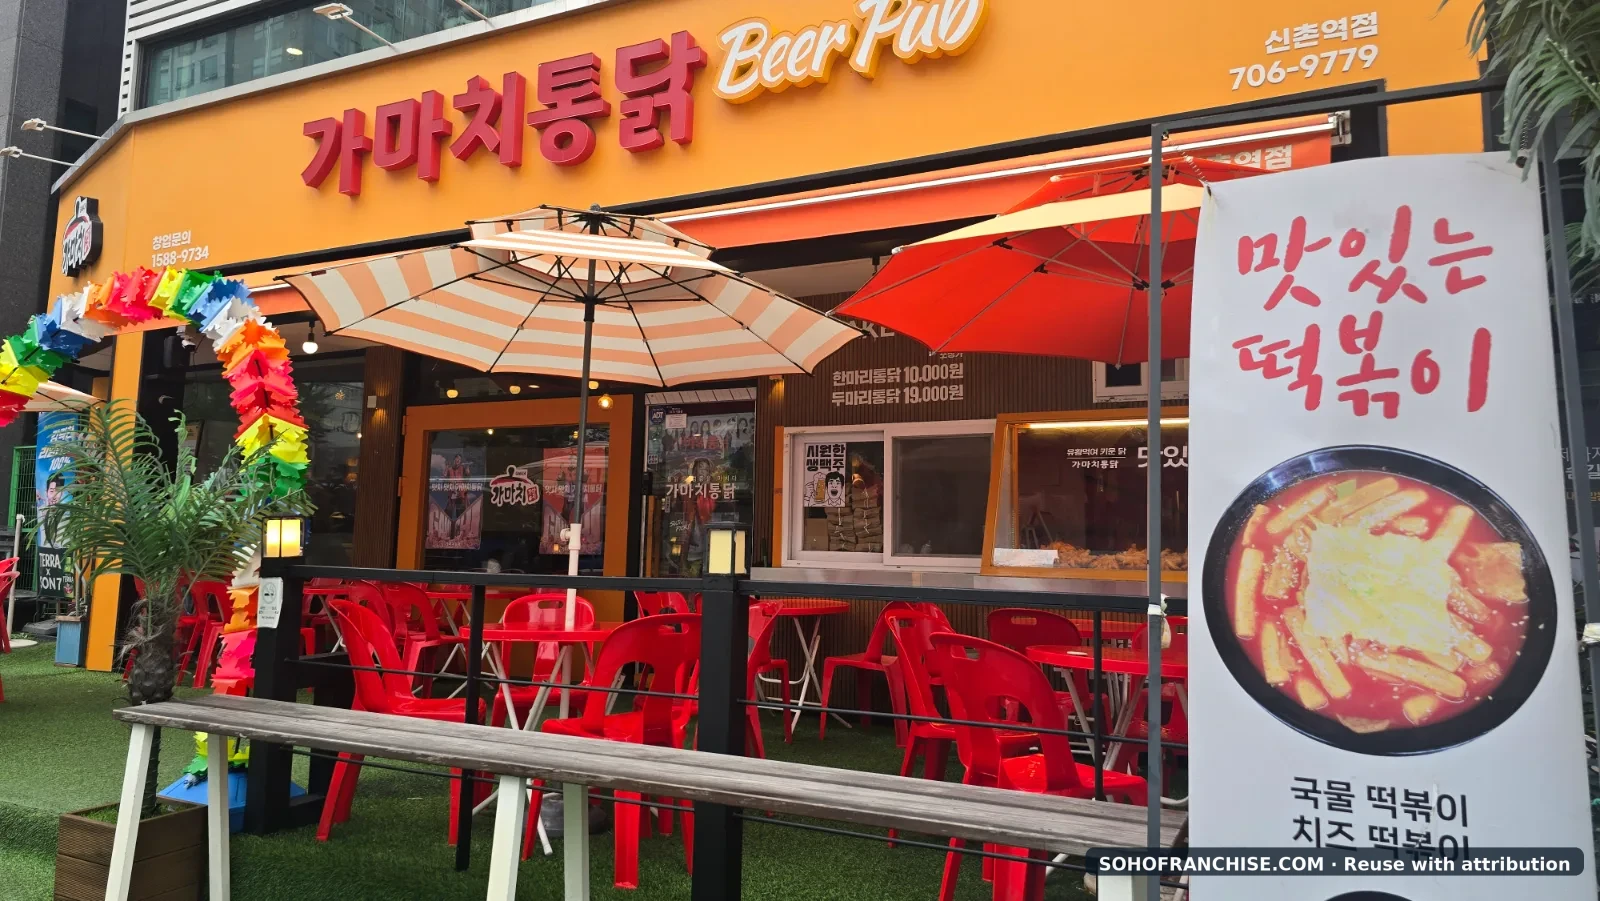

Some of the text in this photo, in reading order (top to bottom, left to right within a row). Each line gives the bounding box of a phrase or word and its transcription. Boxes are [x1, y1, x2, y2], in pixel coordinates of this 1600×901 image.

[1264, 12, 1379, 55] 신촌역점
[714, 19, 850, 98] Beer
[1229, 44, 1379, 90] 706-9779
[301, 30, 707, 198] 가마치통닭
[152, 229, 191, 250] 창업문의
[151, 245, 209, 268] 1588-9734
[1238, 204, 1493, 311] 맛있는
[1232, 310, 1492, 419] 떡볶이
[833, 367, 901, 387] 한마리통닭
[832, 388, 900, 406] 두마리통닭
[651, 411, 664, 420] ADT
[806, 443, 845, 458] 시원한
[806, 458, 845, 472] 생맥주
[1071, 460, 1119, 469] 가마치통닭
[491, 482, 527, 505] 가마치
[666, 482, 737, 500] 가마치통닭
[39, 552, 61, 569] TERRA
[1290, 776, 1468, 828] 국물 떡볶이
[1292, 815, 1470, 863] 치즈 떡볶이
